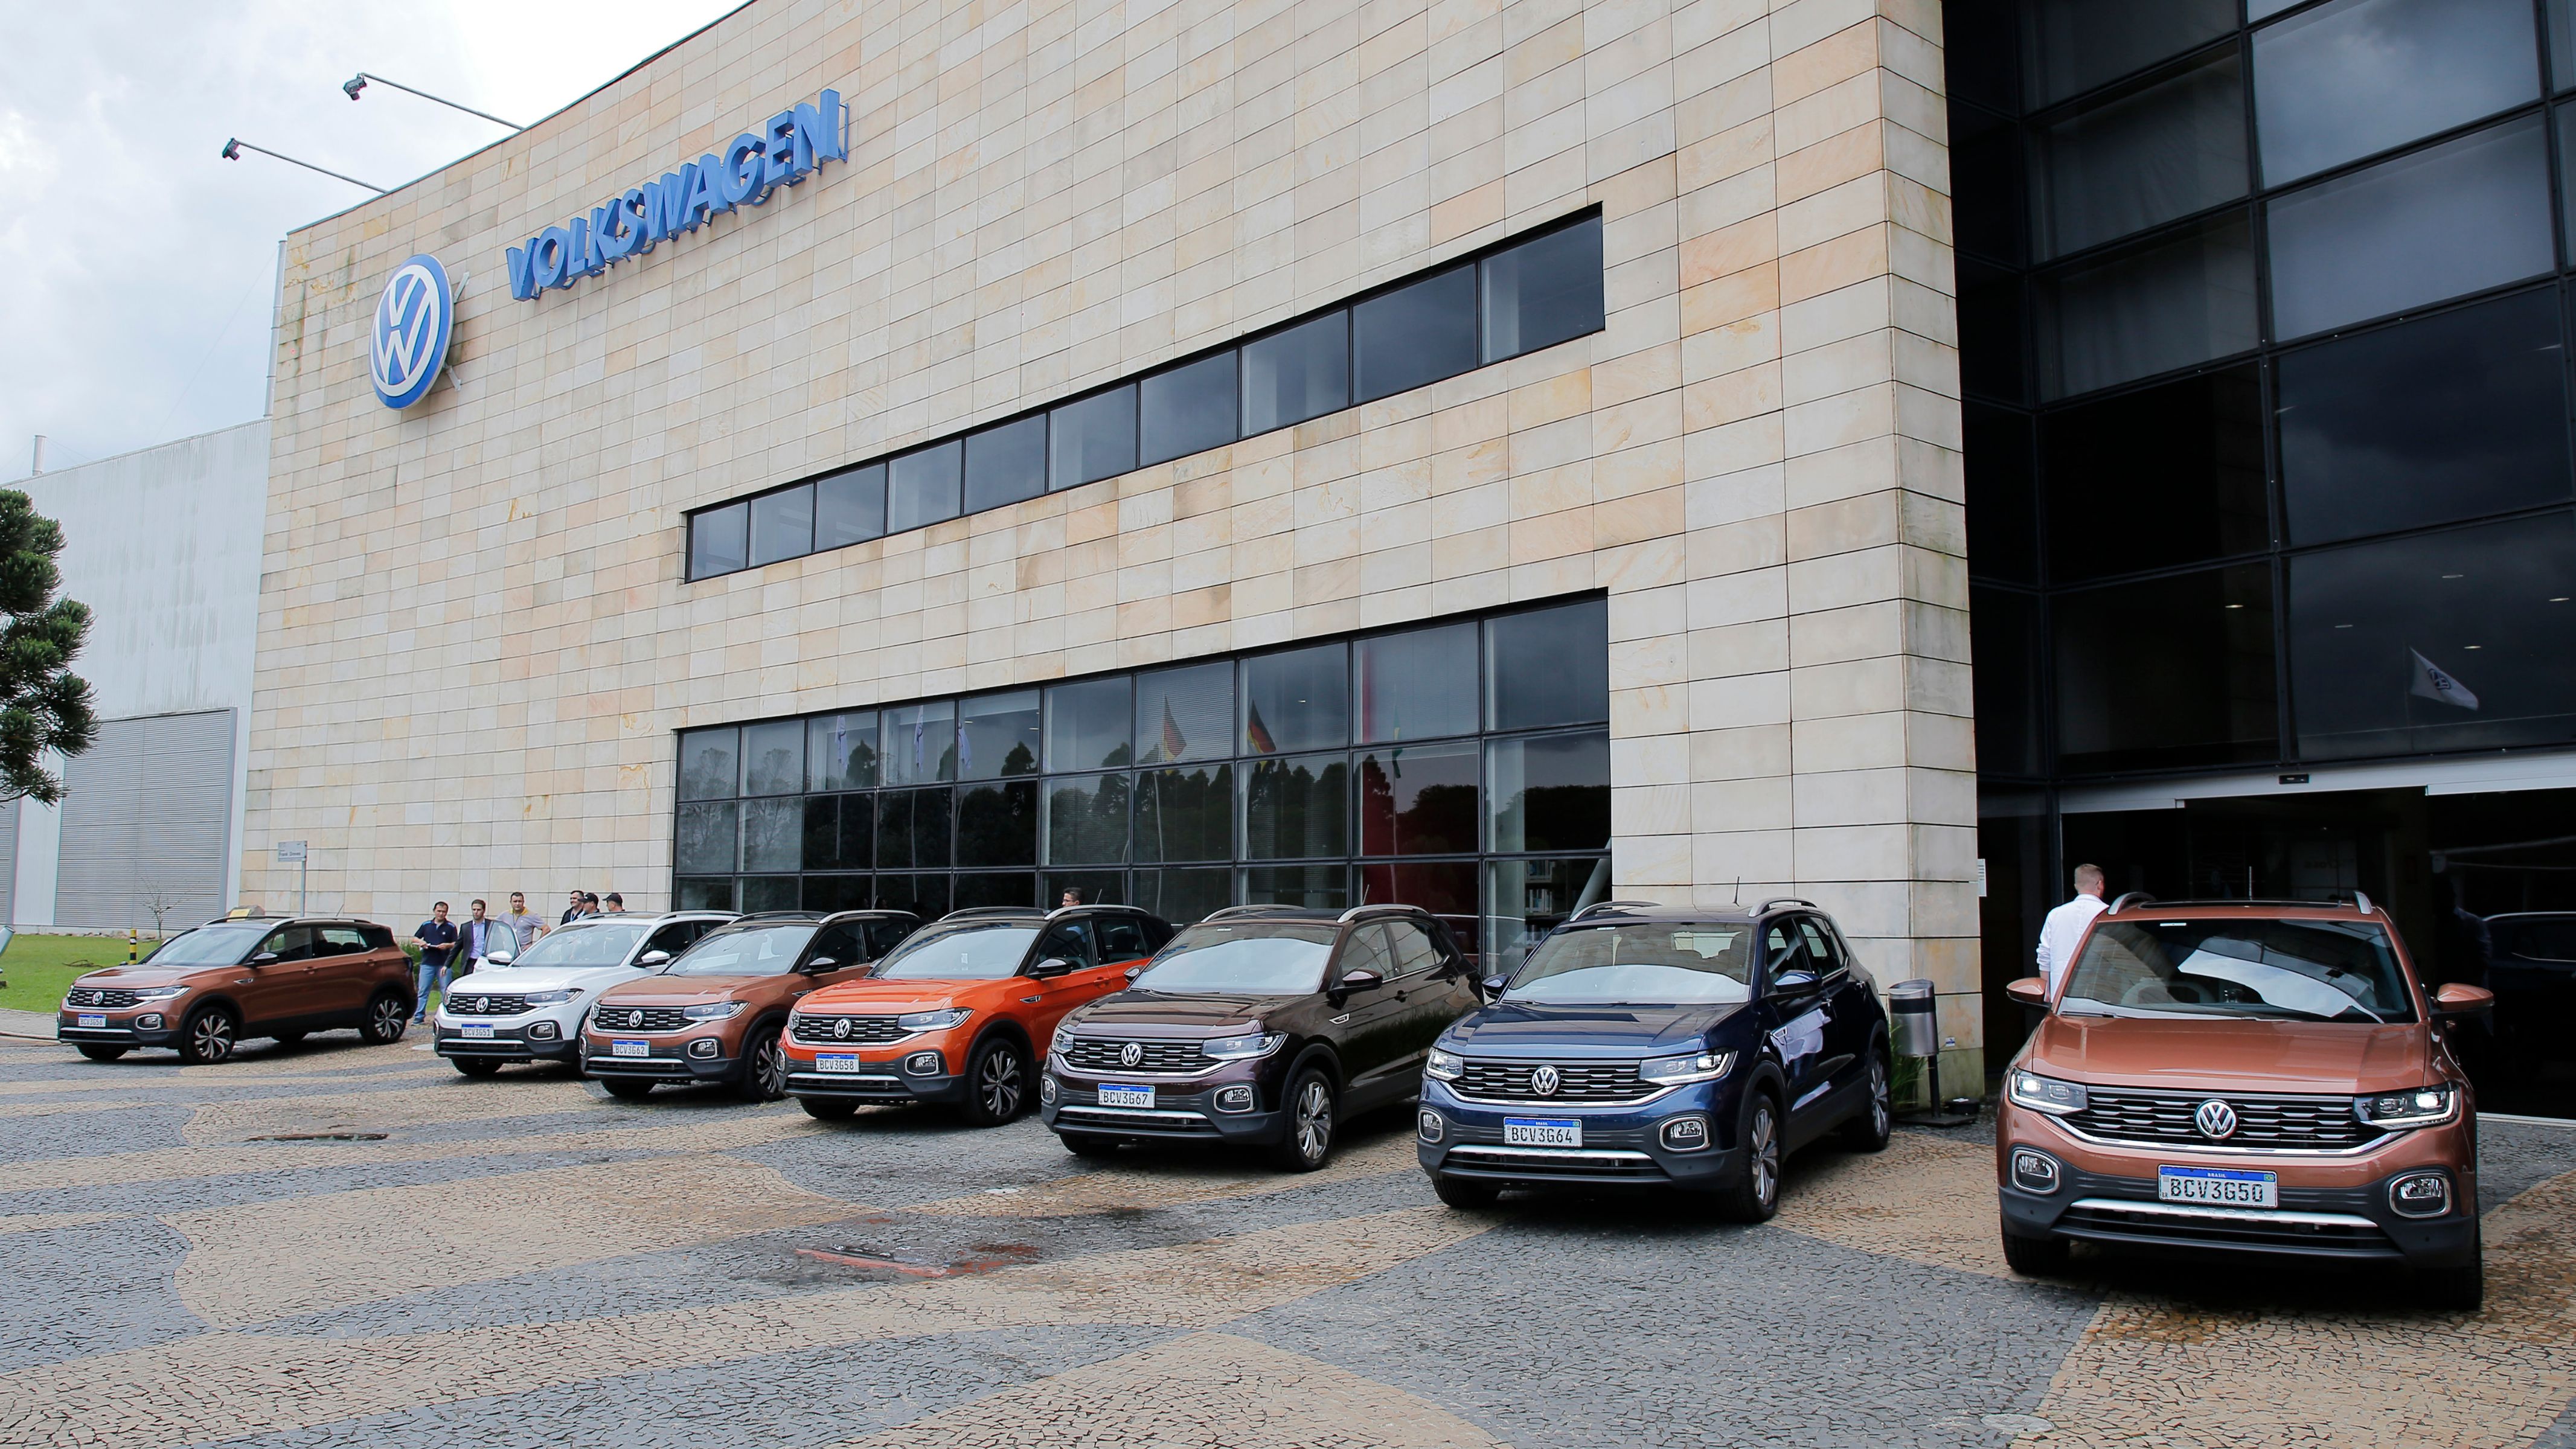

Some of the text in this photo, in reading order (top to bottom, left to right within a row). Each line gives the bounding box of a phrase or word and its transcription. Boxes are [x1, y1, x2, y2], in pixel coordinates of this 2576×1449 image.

[506, 89, 840, 301] VOLKSWAGEN
[370, 264, 440, 397] VW
[476, 997, 488, 1012] VW
[629, 1010, 642, 1027] VW
[834, 1019, 850, 1038] VW
[615, 1045, 645, 1055] BCV3G62
[1121, 1044, 1141, 1066] VW
[820, 1060, 854, 1070] BCV3G58
[1531, 1066, 1559, 1096] VW
[1103, 1091, 1148, 1105] BCV3G67
[2195, 1100, 2237, 1139] VW
[1511, 1127, 1572, 1143] BCV3G64
[2170, 1178, 2263, 1203] BCV3G50
